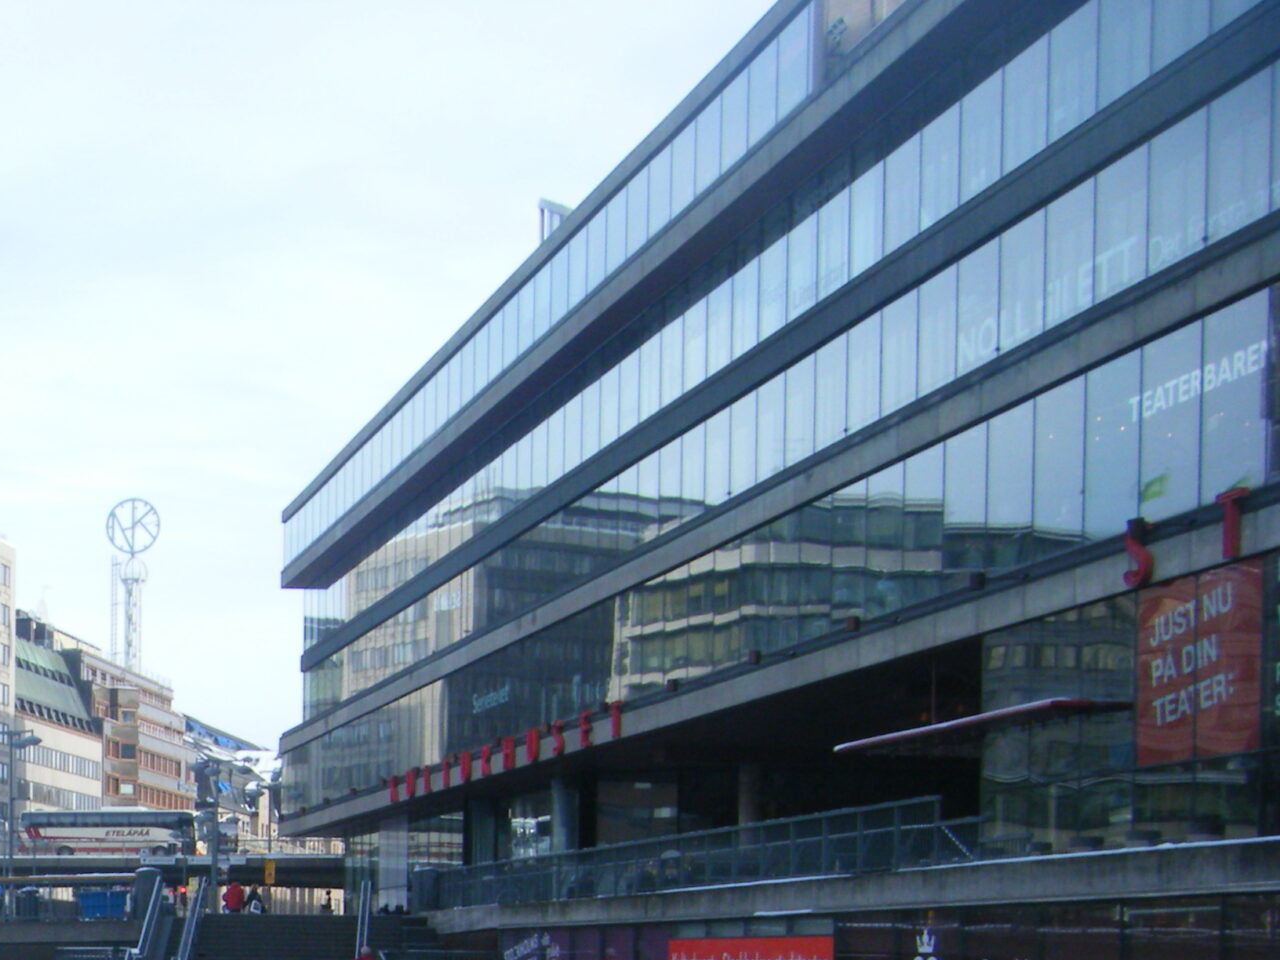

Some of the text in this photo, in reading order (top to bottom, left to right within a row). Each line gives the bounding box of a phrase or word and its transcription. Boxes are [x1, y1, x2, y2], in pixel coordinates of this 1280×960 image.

[1150, 582, 1233, 647] JUST NU
[1151, 635, 1221, 687] PÅ DIN
